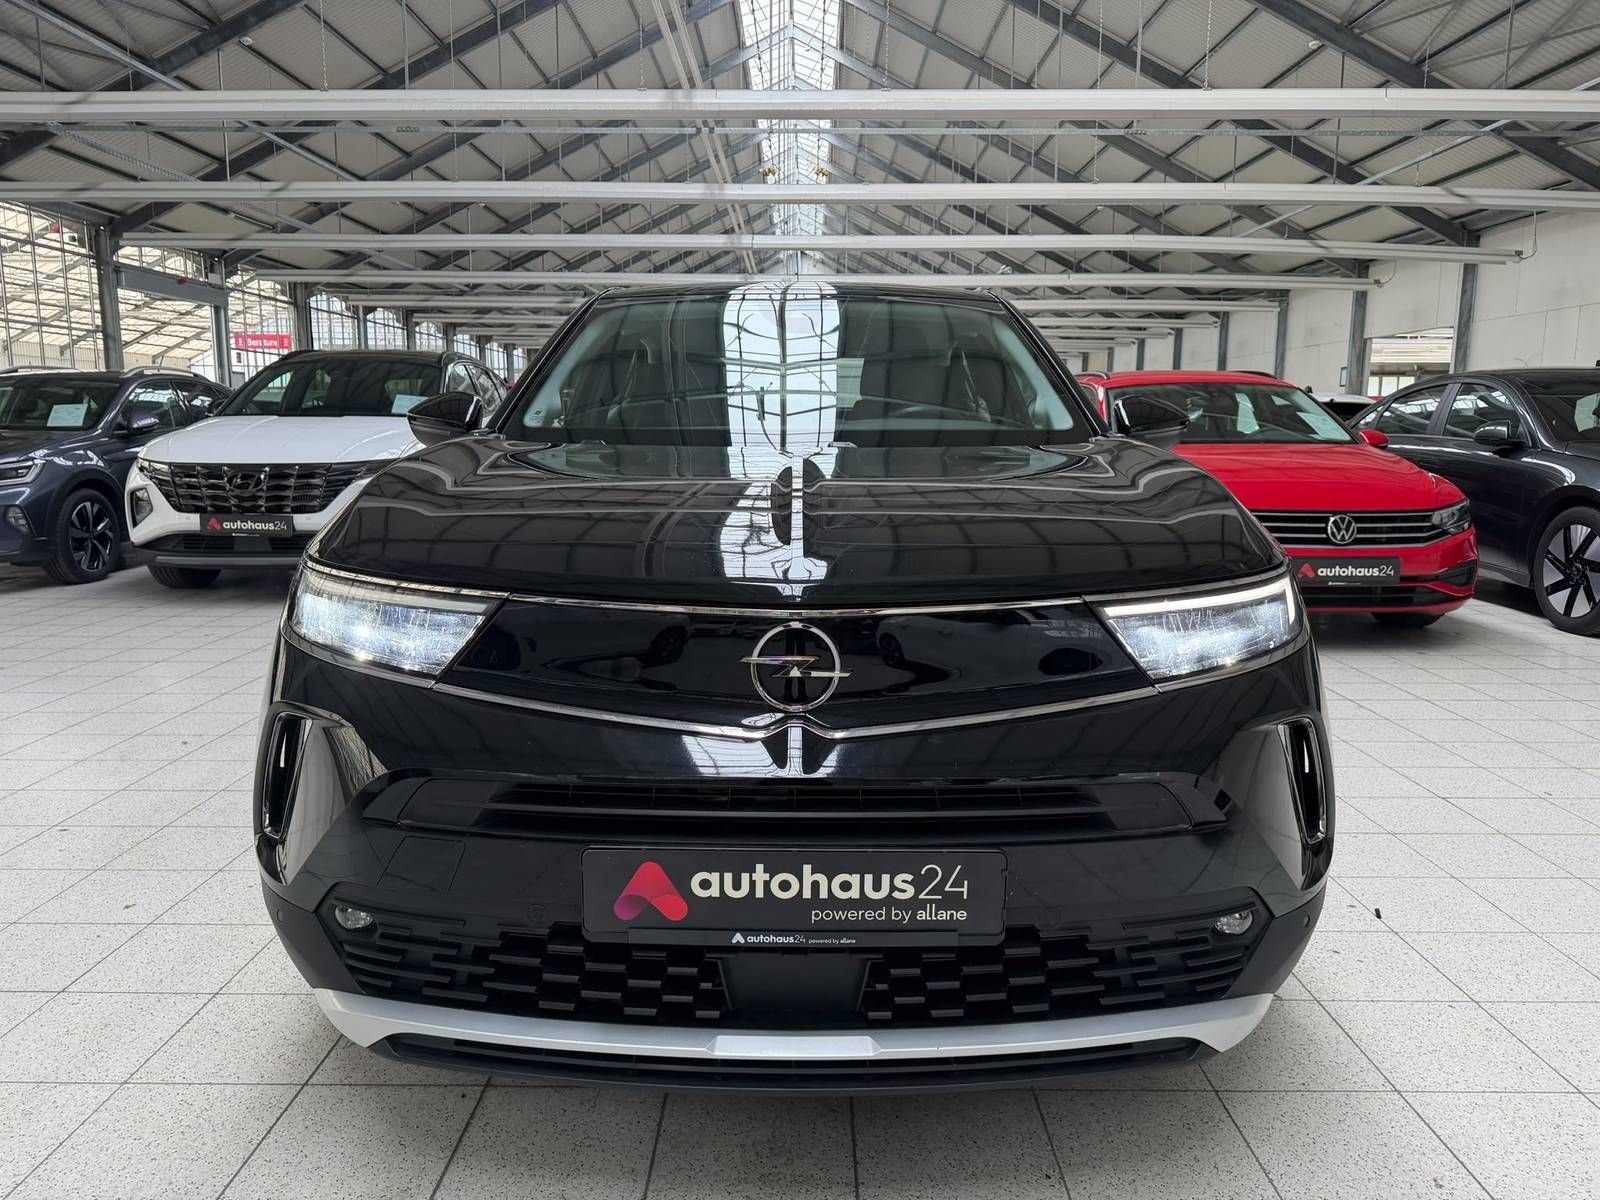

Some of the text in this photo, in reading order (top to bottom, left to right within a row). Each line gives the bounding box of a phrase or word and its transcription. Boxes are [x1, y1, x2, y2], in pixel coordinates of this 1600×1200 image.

[222, 520, 287, 530] autohaus24
[1317, 565, 1395, 576] autohaus24
[690, 863, 968, 900] autohaus24
[811, 903, 968, 924] powered by allane
[746, 934, 806, 944] autohaus24
